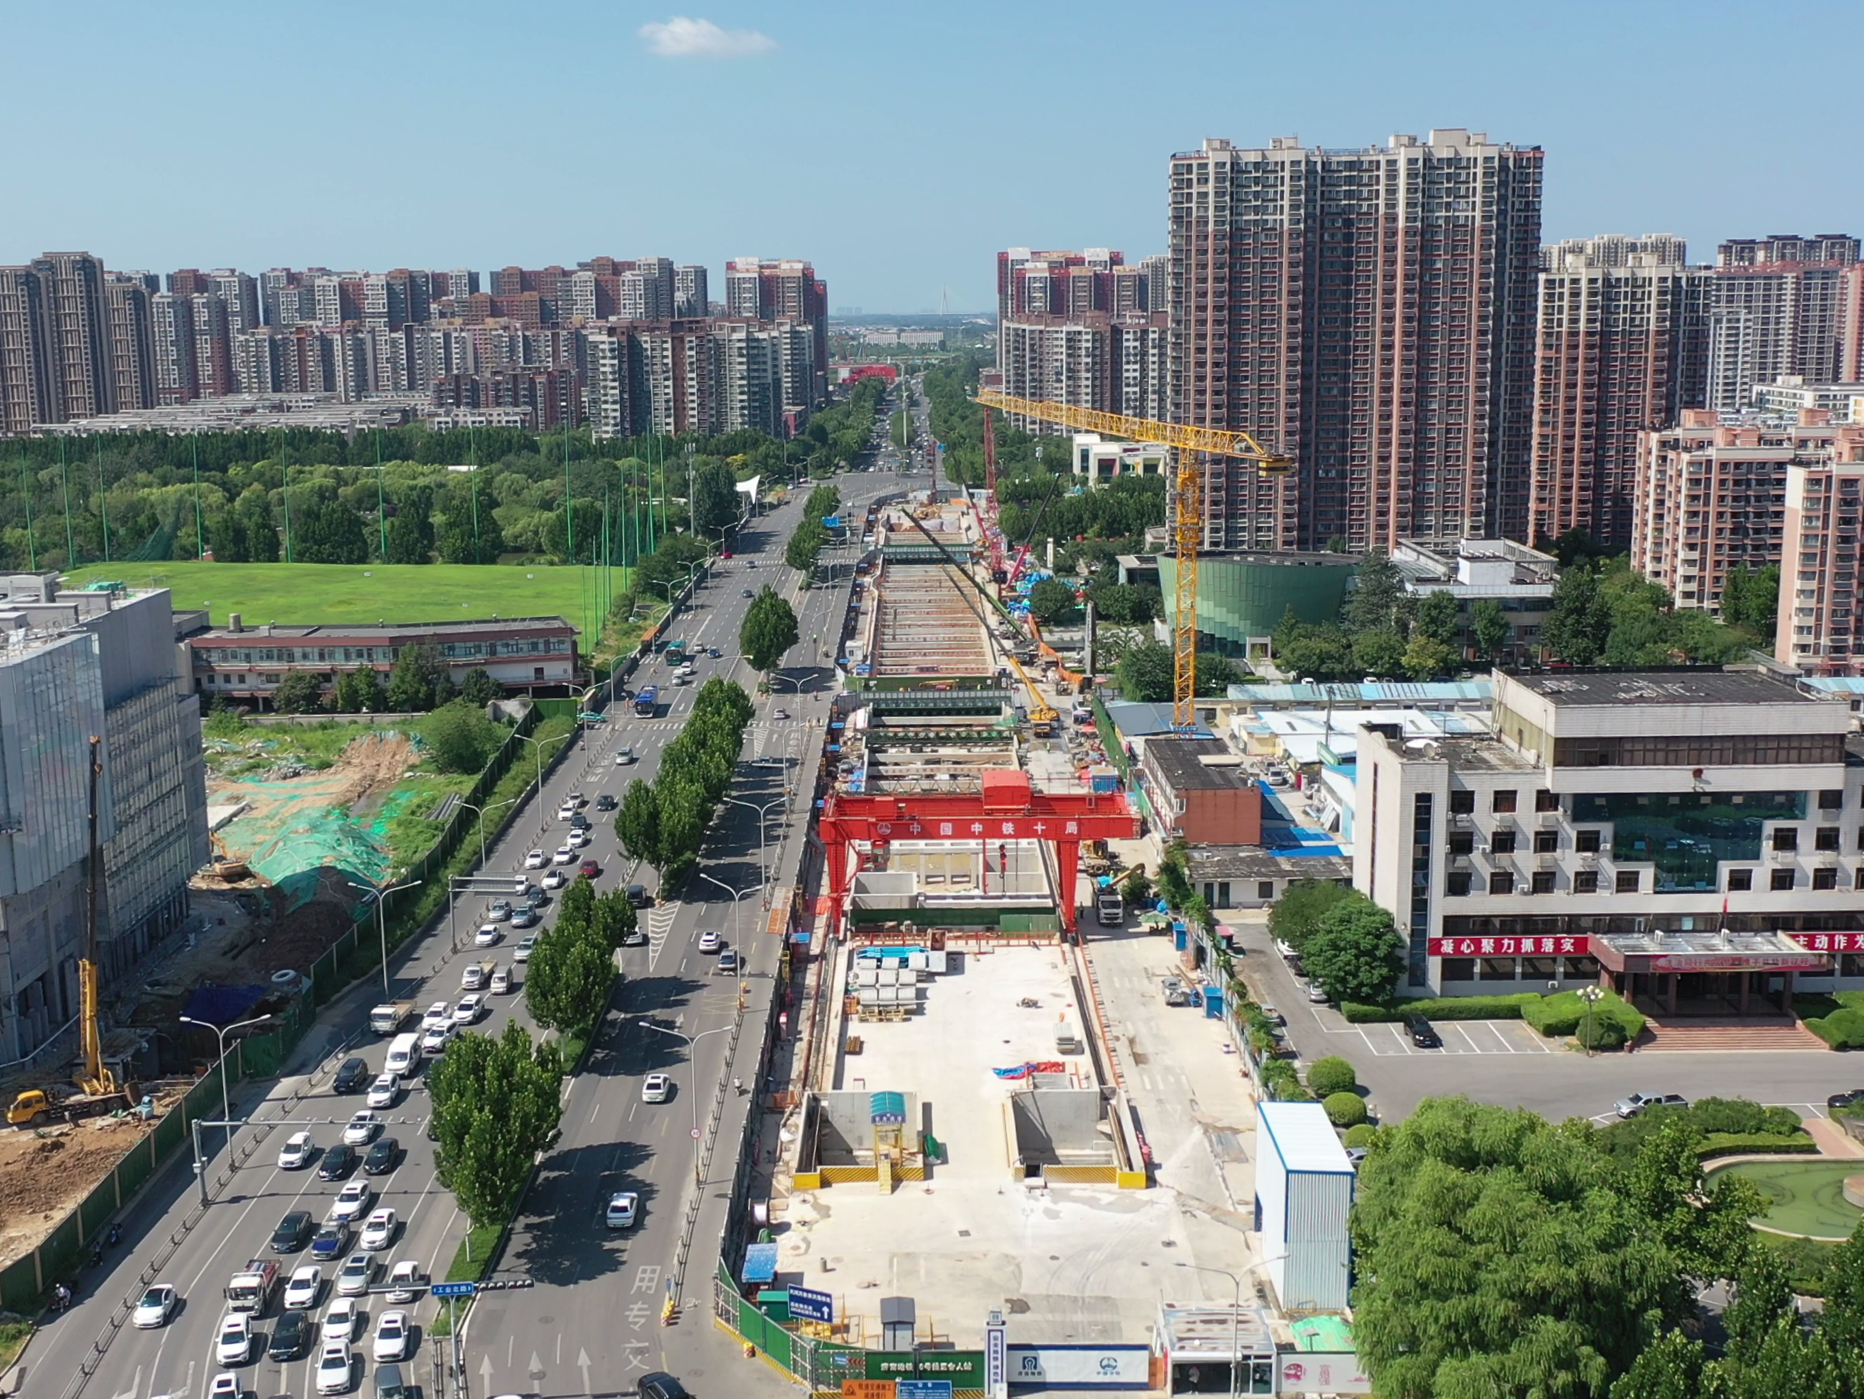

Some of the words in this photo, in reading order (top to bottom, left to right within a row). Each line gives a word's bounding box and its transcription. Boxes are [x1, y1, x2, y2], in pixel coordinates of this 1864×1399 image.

[1440, 938, 1575, 954] 凝心聚力抓落实
[437, 1285, 467, 1293] 工业北路
